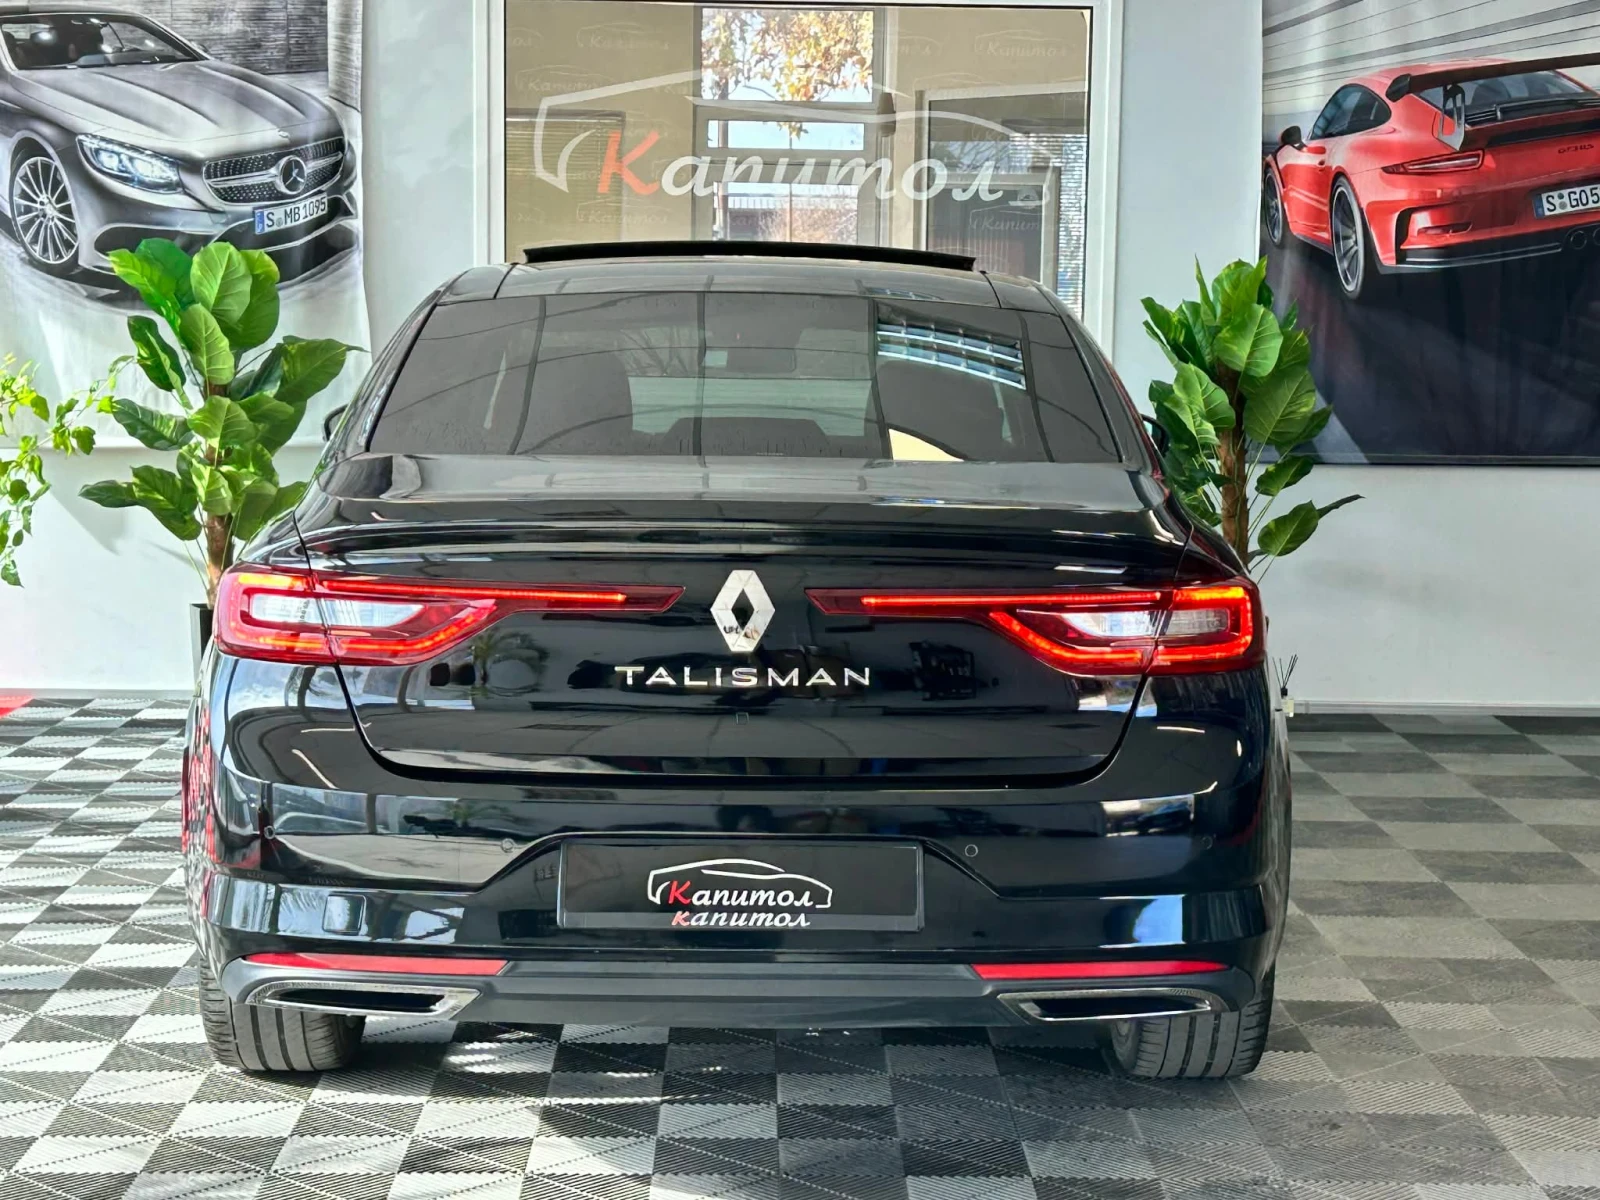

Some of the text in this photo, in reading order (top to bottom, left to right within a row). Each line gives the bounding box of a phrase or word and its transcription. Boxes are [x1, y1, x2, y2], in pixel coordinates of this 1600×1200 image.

[599, 130, 1003, 201] Капитол
[614, 665, 870, 687] TALISMAN
[668, 880, 814, 907] Капитол
